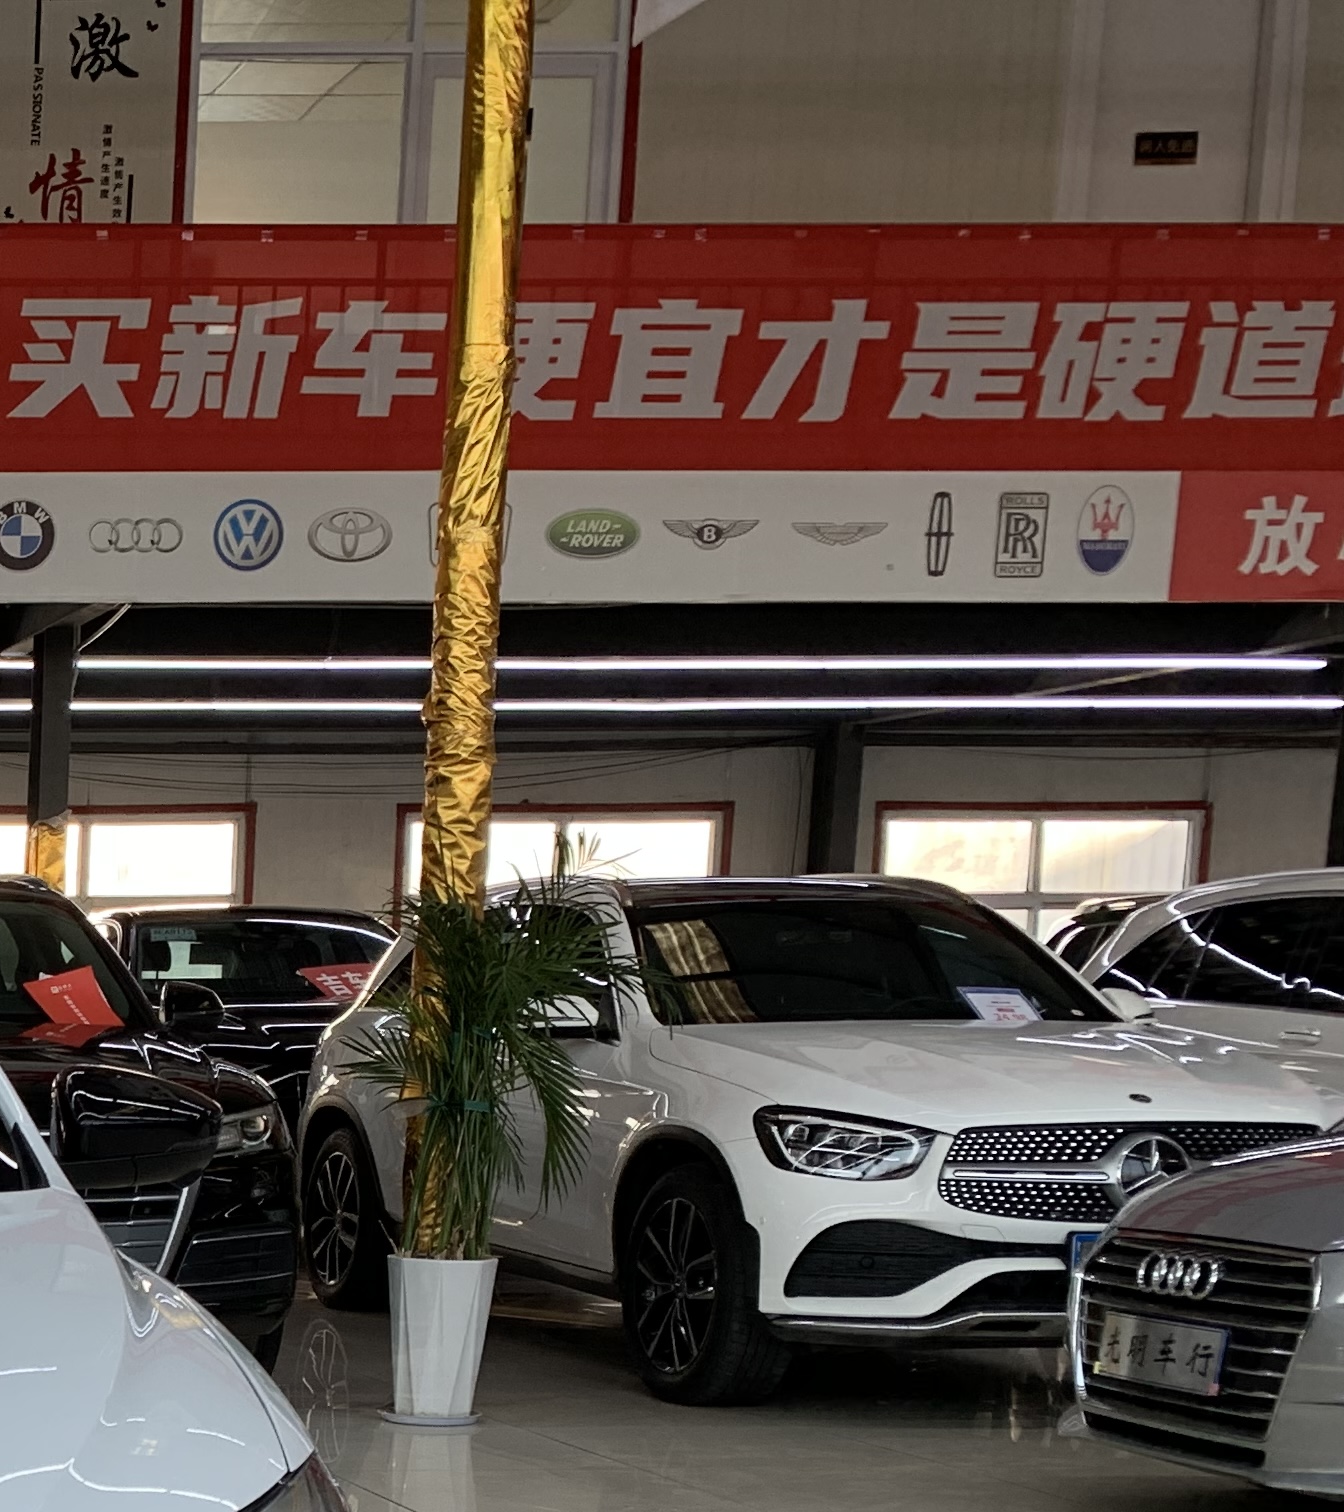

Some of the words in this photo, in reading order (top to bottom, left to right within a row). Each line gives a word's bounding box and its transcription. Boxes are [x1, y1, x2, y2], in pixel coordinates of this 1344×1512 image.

[30, 67, 44, 146] PASSIONATE
[112, 157, 124, 223] 激情产生效
[999, 565, 1037, 575] ROYCE
[1238, 494, 1344, 576] 放
